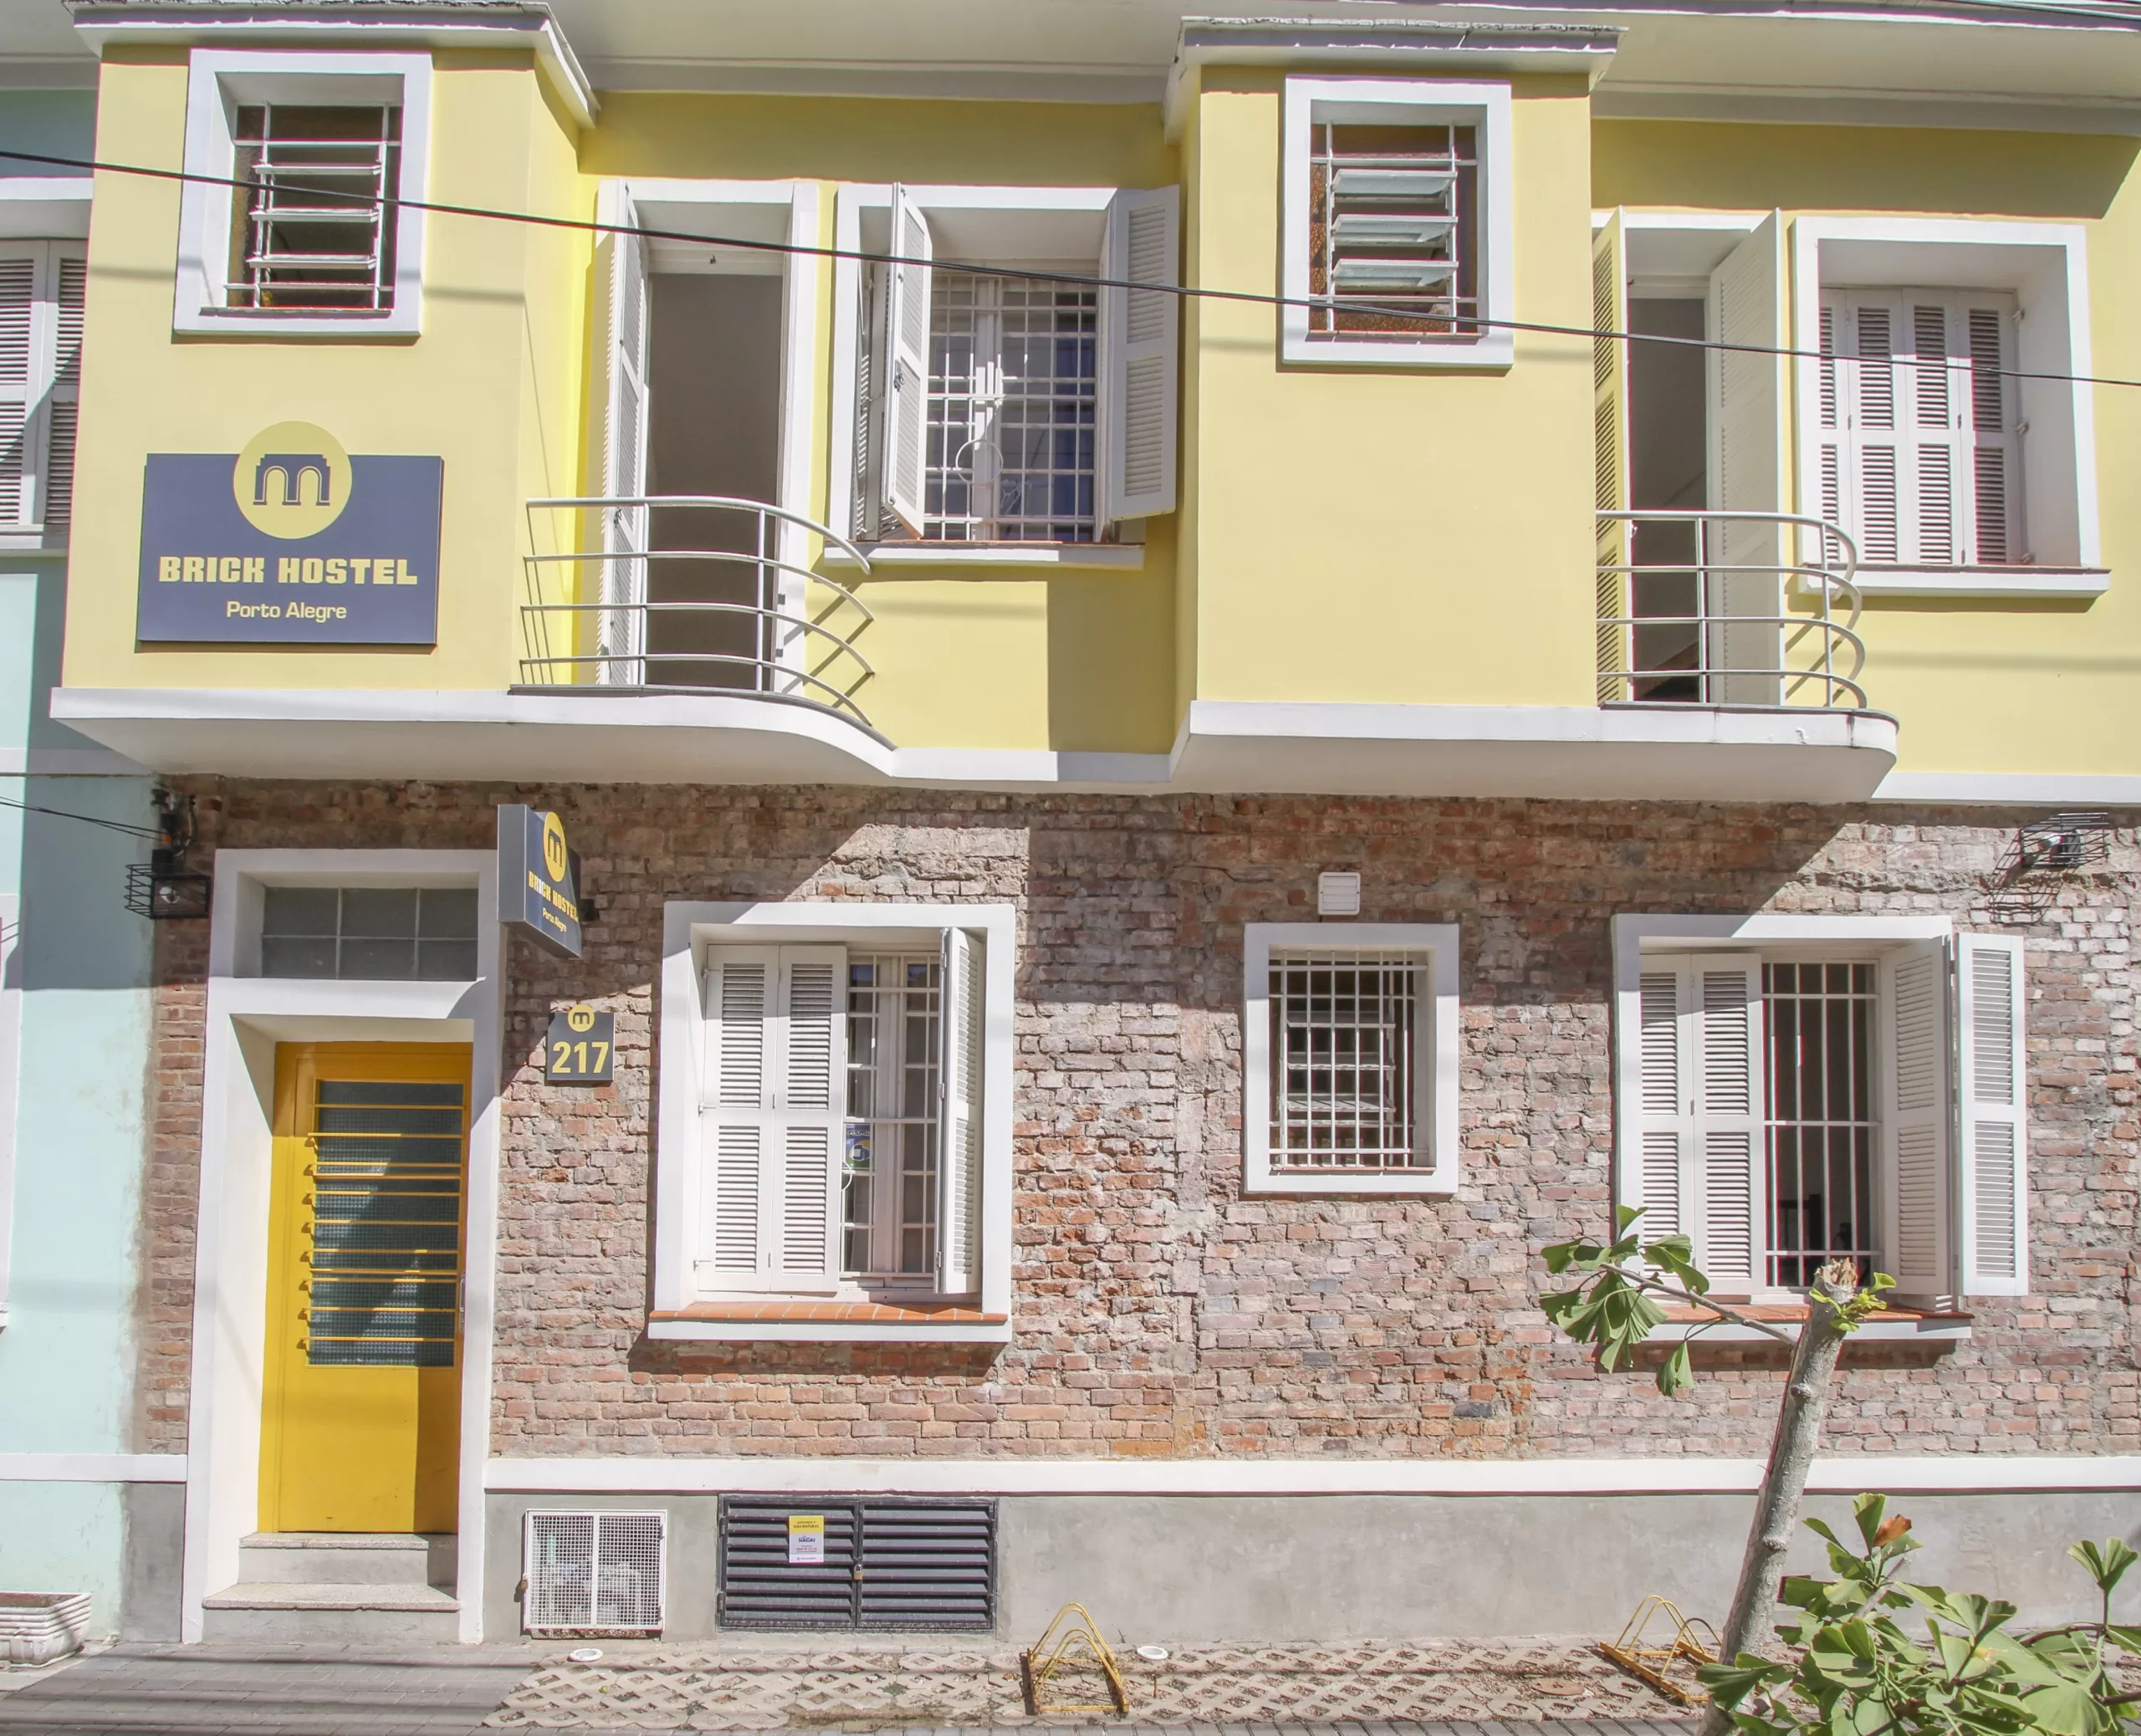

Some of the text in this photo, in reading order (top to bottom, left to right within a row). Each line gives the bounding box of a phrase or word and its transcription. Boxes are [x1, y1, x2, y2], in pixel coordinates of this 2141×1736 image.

[158, 555, 418, 585] BRICK HOSTEL
[226, 600, 347, 623] Porto Alegre
[528, 870, 580, 923] BRICK HOSTEL
[551, 1040, 610, 1075] 217
